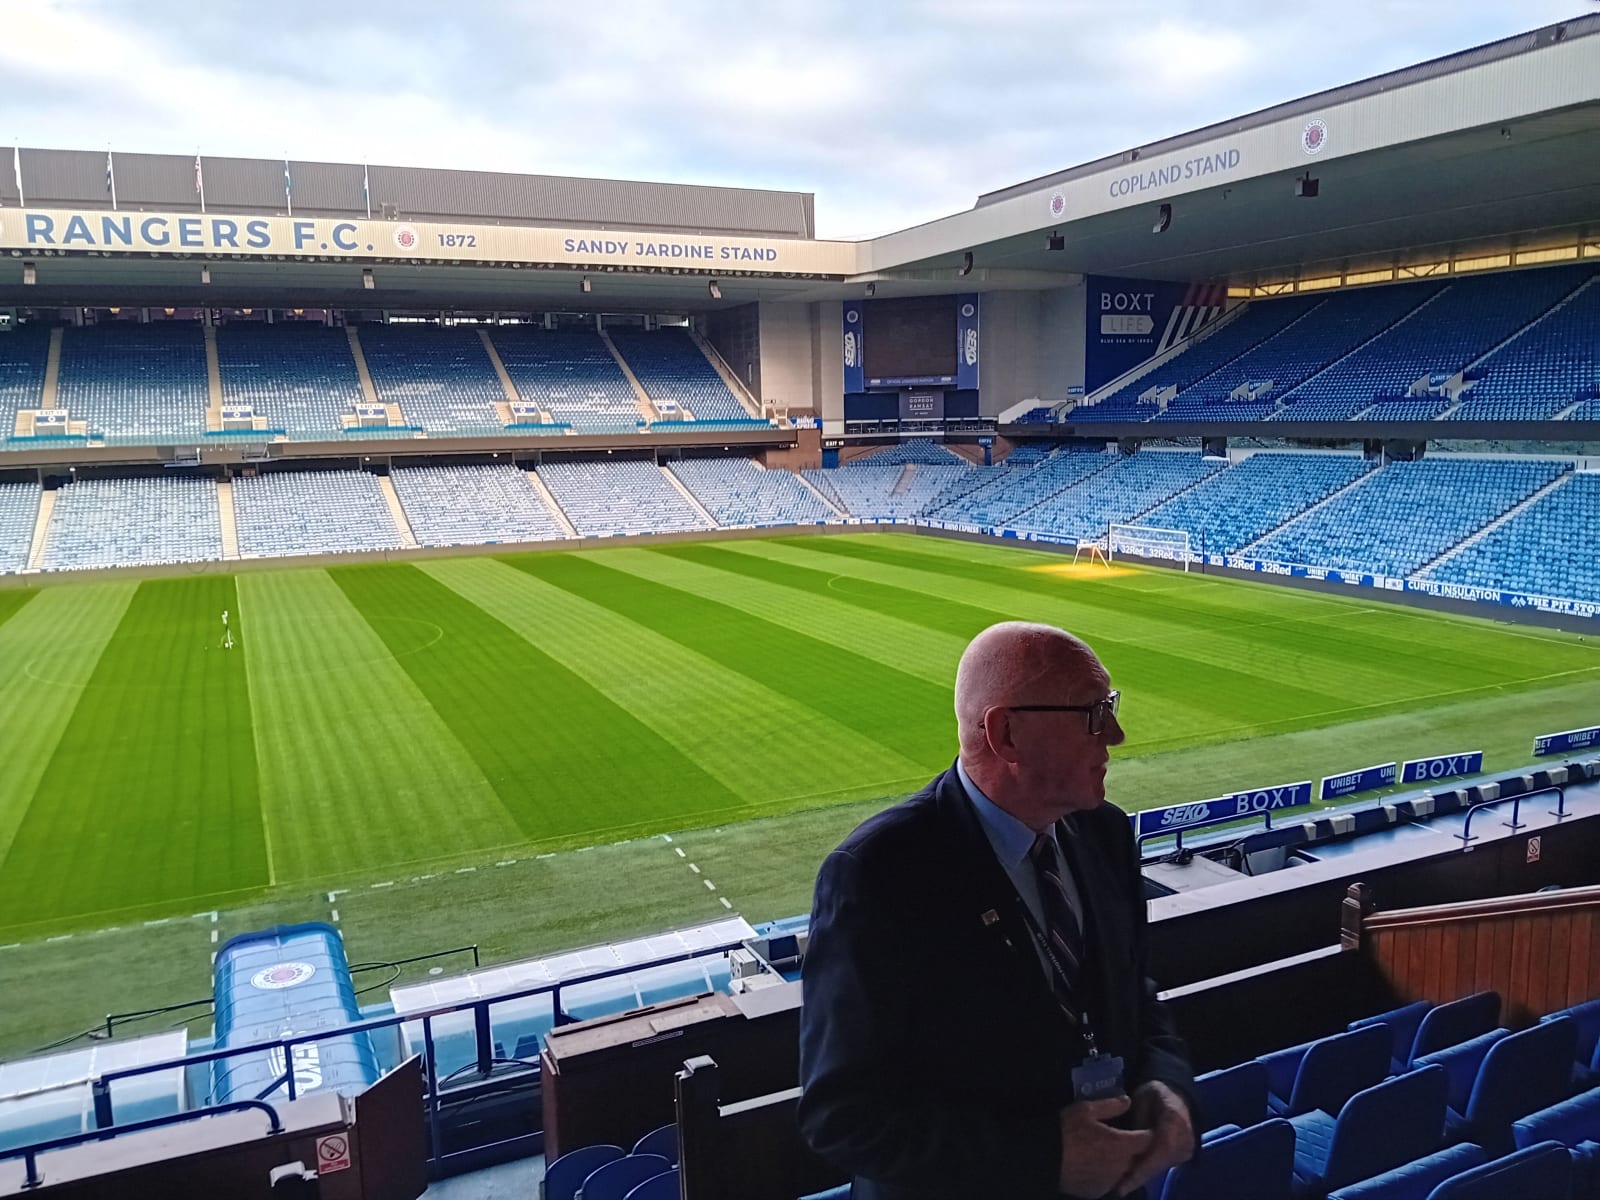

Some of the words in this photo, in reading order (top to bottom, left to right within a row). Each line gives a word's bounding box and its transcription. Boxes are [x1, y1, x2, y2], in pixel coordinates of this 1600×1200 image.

[1109, 164, 1182, 198] COPLAND
[1184, 148, 1241, 179] STAND
[25, 214, 272, 249] RANGERS
[294, 222, 375, 251] F.C.
[438, 233, 477, 248] 1872
[564, 238, 630, 256] SANDY
[636, 242, 714, 259] JARDINE
[720, 246, 778, 262] STAND
[1100, 292, 1155, 311] BOXT
[1109, 317, 1145, 333] LIFE
[844, 331, 857, 368] SEKO
[964, 328, 977, 367] SEKO
[1121, 544, 1144, 556] 32Red
[1149, 548, 1174, 560] 32Red
[1226, 557, 1256, 571] 32Red
[1261, 561, 1292, 576] 32Red
[1307, 566, 1329, 577] UNIBET
[1340, 571, 1364, 582] UNIBET
[1407, 581, 1439, 593] CURTIS
[1441, 585, 1500, 602] INSULATION
[1527, 596, 1549, 608] THE
[1551, 600, 1571, 610] PIT
[1568, 730, 1600, 744] UNIBET
[1380, 764, 1396, 778] UNI
[1415, 755, 1473, 781] BOXT
[1330, 773, 1363, 790] UNIBET
[1236, 786, 1301, 814] BOXT
[1160, 804, 1210, 825] SEKO
